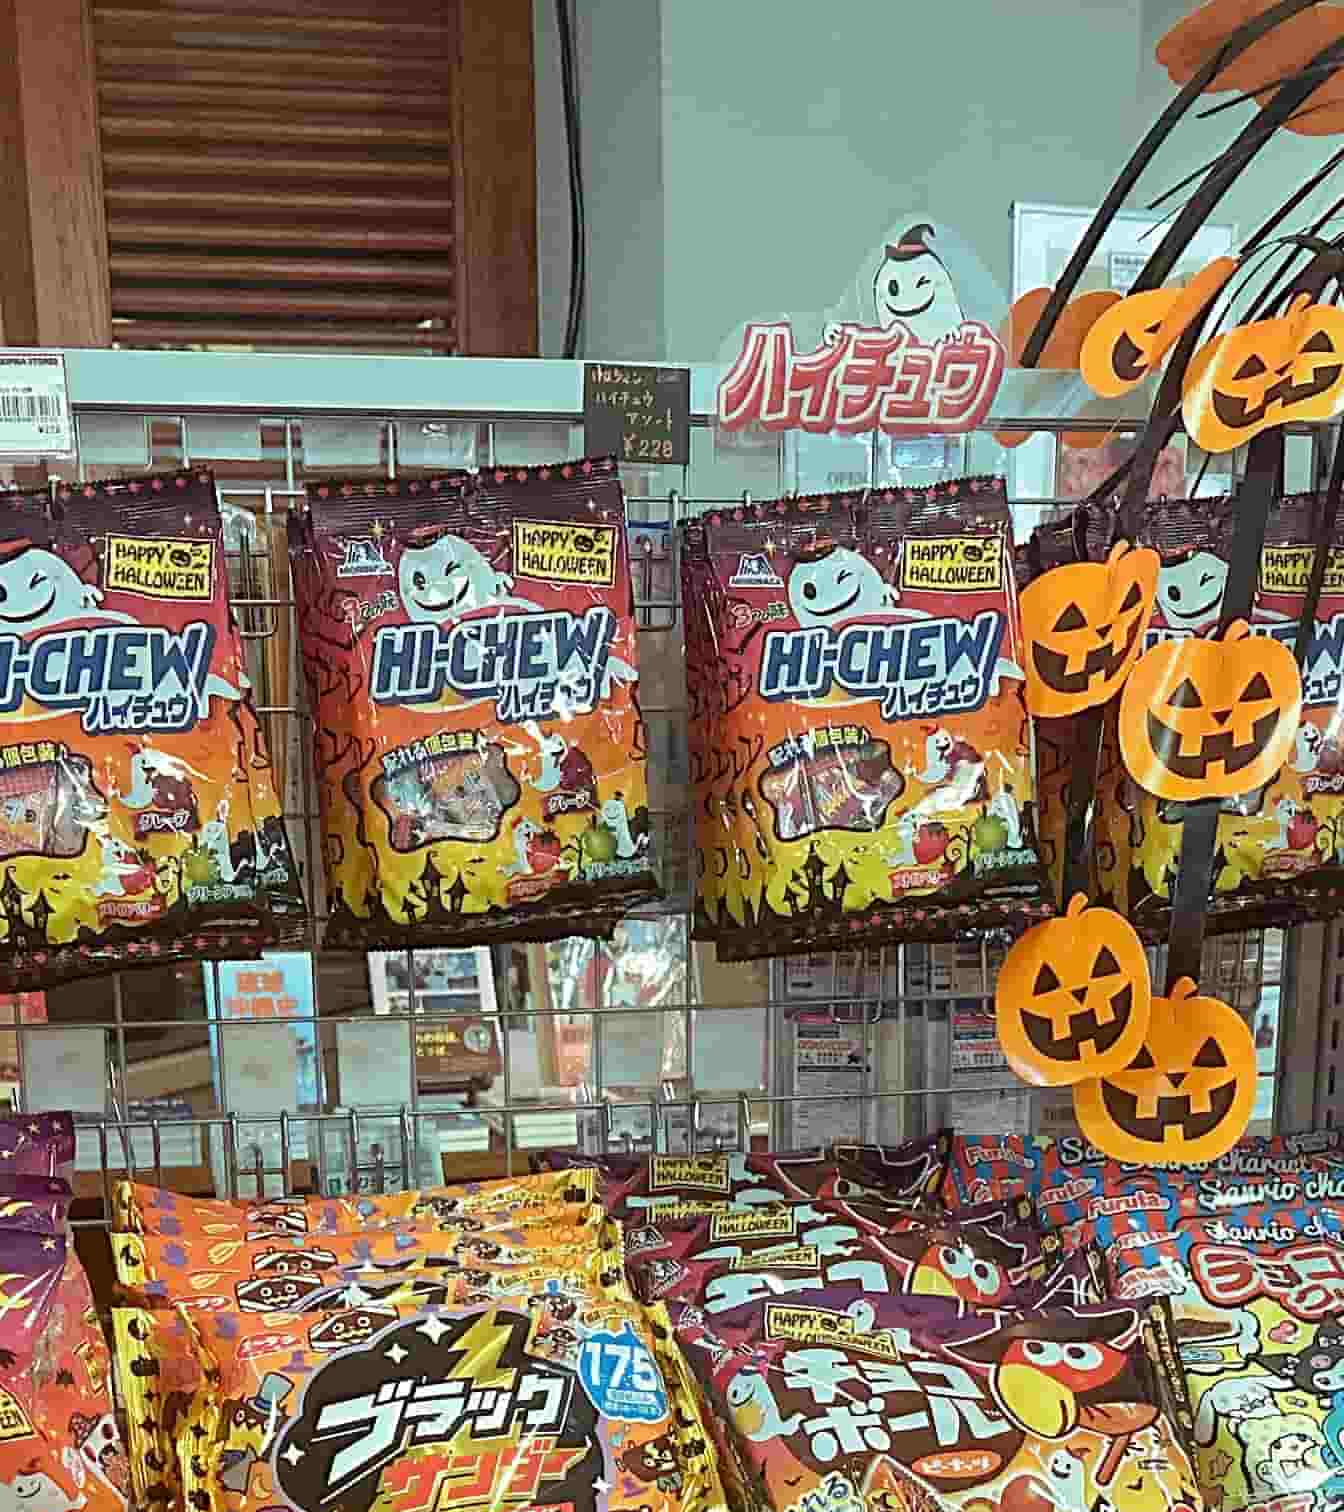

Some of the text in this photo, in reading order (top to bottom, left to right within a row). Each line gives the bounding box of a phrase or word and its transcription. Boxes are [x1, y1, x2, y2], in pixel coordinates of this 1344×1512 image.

[718, 321, 1008, 434] ハイチュウ
[115, 543, 168, 564] HAPPY
[522, 527, 569, 549] HAPPY
[910, 542, 959, 562] HAPPY
[114, 567, 205, 591] HALLOWEEN
[521, 551, 608, 577] HALLOWEEN
[909, 565, 996, 585] HALLOWEEN
[372, 607, 616, 703] HI-CHEW
[761, 610, 1008, 702] HI-CHEW
[84, 694, 196, 732] ハイチュウ
[882, 683, 982, 720] ハイチュウ
[1200, 1178, 1296, 1210] Sanrio
[584, 1340, 658, 1390] 175
[316, 1370, 574, 1487] ブラック
